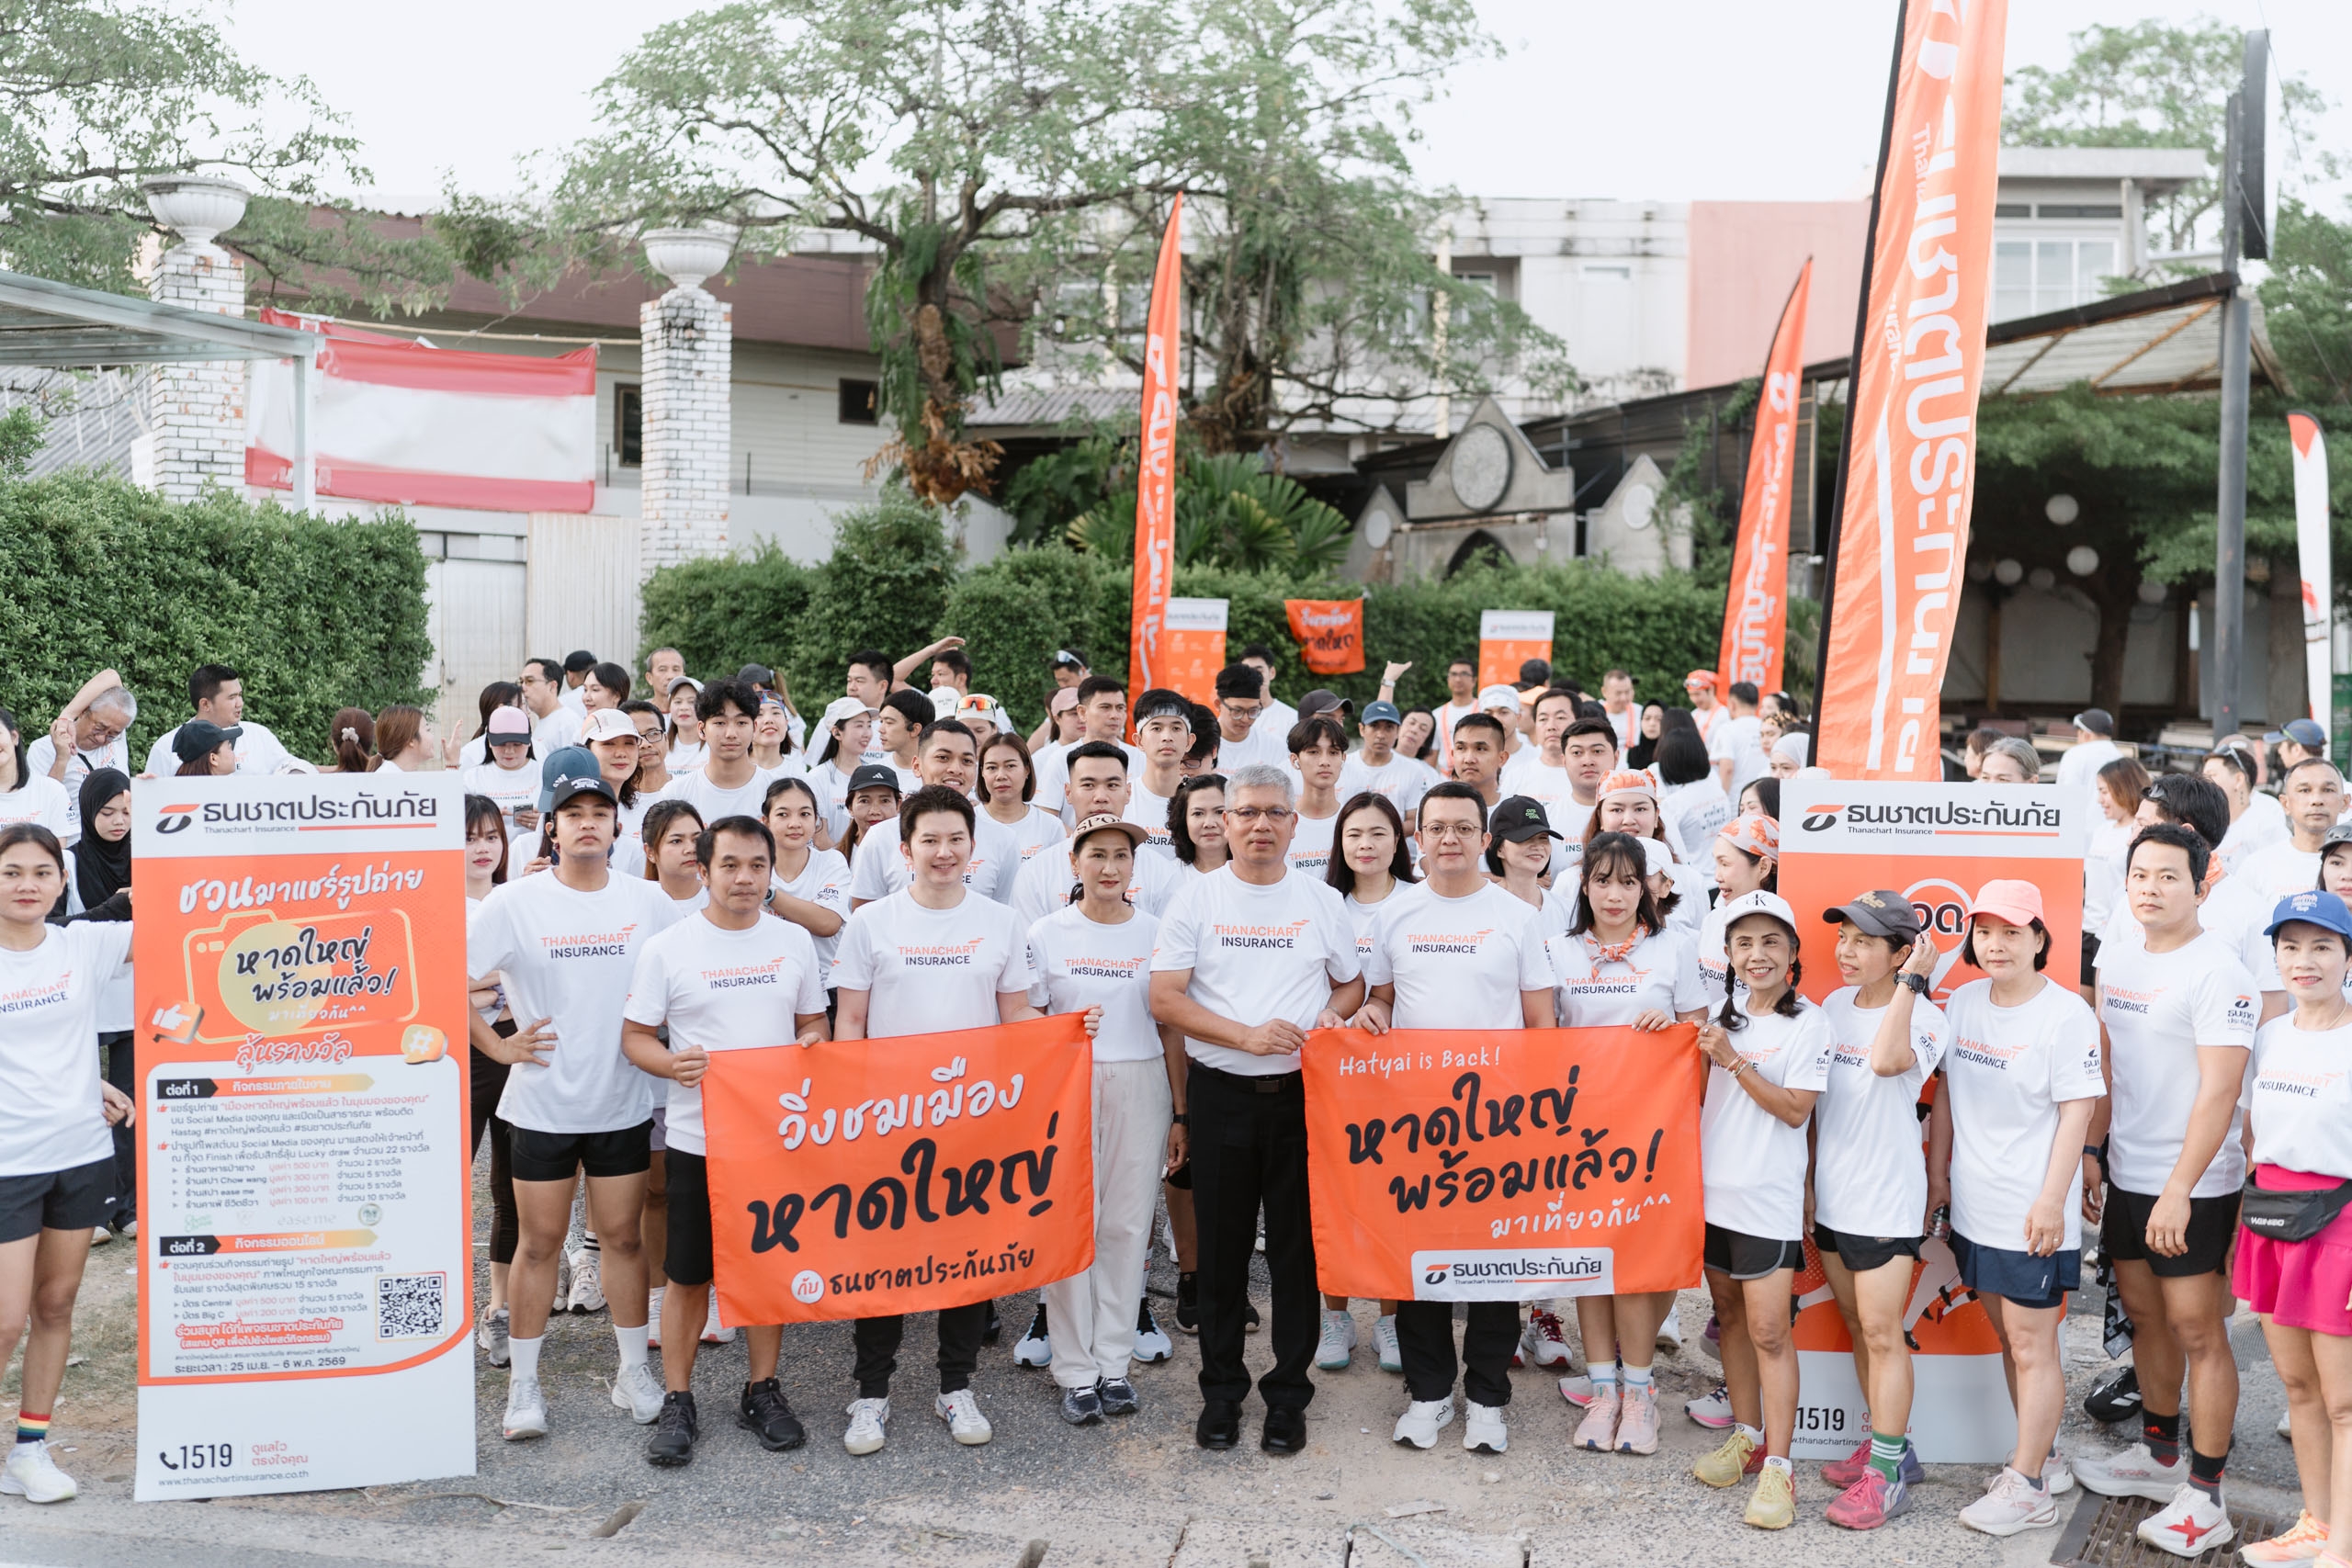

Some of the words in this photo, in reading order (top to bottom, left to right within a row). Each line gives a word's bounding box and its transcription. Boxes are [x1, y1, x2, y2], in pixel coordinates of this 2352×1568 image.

[203, 791, 436, 822] ธนชาตประกันภัย
[1847, 800, 2061, 828] ธนชาตประกันภัย
[204, 826, 252, 834] Thanachart
[254, 824, 296, 833] Insurance
[1848, 827, 1893, 835] Thanachart
[1895, 828, 1933, 836] Insurance
[1289, 850, 1331, 861] THANACH
[1295, 858, 1330, 869] INSURA
[179, 861, 424, 913] ชวนมาแชร์รูปถ่าย
[1213, 924, 1302, 938] THANACHART
[540, 931, 632, 948] THANACHART
[1221, 936, 1294, 949] INSURANCE
[1407, 933, 1486, 945] THANACHART
[236, 926, 372, 976] หาดใหญ่
[550, 944, 626, 959] INSURANCE
[898, 944, 978, 956] THANACHART
[1411, 943, 1477, 954] INSURANCE
[905, 954, 971, 965] INSURANCE
[1065, 958, 1140, 971] THANACHART
[701, 964, 781, 981] THANACHART
[1070, 966, 1135, 979] INSURANCE
[253, 960, 398, 1002] พร้อมแล้ว!
[710, 974, 778, 989] INSURANCE
[1565, 975, 1645, 986] THANACHART
[2, 979, 70, 1002] ANACHART
[1570, 985, 1637, 995] INSURANCE
[2105, 984, 2158, 1003] THANACHART
[2105, 998, 2149, 1014] INSURANCE
[235, 1032, 353, 1073] ลุ้นรางวัล
[1340, 1051, 1411, 1079] Hatyai
[1419, 1053, 1432, 1070] is
[1441, 1045, 1501, 1068] Back!
[165, 1081, 191, 1096] ต่อที่
[192, 1085, 198, 1095] 1
[2257, 1080, 2321, 1099] INSURANCE
[778, 1055, 1024, 1151] วิ่งชมเมือง
[187, 1115, 214, 1124] Social
[216, 1114, 243, 1123] Media
[1345, 1065, 1581, 1165] หาดใหญ่
[171, 1128, 202, 1137] Hastag
[242, 1139, 269, 1148] Social
[271, 1138, 299, 1147] Media
[206, 1152, 233, 1162] Finish
[299, 1149, 325, 1159] Lucky
[329, 1148, 349, 1157] draw
[386, 1145, 398, 1154] 22
[1388, 1128, 1664, 1214] พร้อมแล้ว!
[246, 1177, 267, 1185] wang
[747, 1110, 1058, 1254] หาดใหญ่
[169, 1238, 195, 1253] ต่อที่
[196, 1242, 205, 1253] 2
[797, 1277, 820, 1296] กับ
[829, 1241, 1035, 1296] ธนชาตประกันภัย
[1453, 1256, 1601, 1279] ธนชาตประกันภัย
[295, 1280, 304, 1289] 15
[202, 1299, 232, 1307] Central
[202, 1311, 216, 1320] Big
[211, 1338, 225, 1348] QR
[175, 1363, 222, 1374] ระยะเวลา
[230, 1361, 244, 1371] 25
[282, 1359, 290, 1369] 6
[318, 1356, 346, 1367] 2569
[1796, 1406, 1845, 1432] 1519
[179, 1443, 232, 1470] 1519
[158, 1471, 309, 1486] www.thanachartinsurance.co.th
